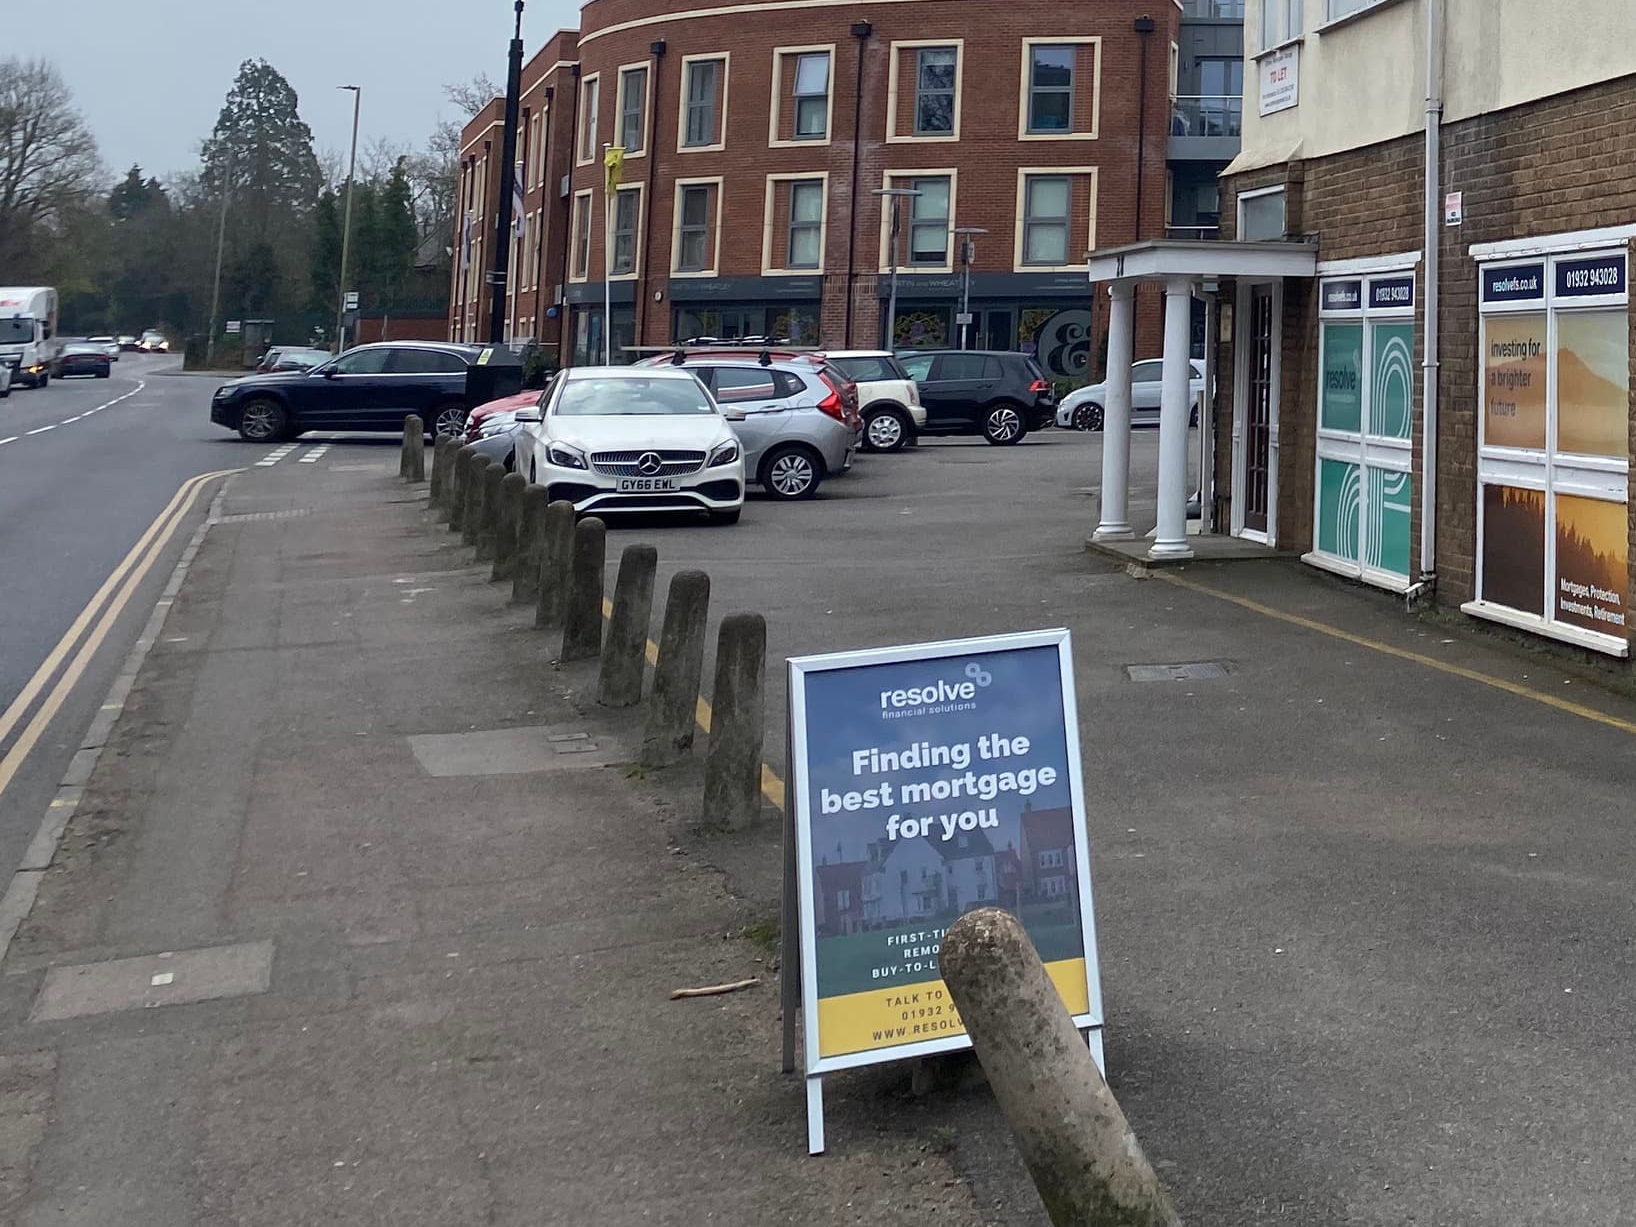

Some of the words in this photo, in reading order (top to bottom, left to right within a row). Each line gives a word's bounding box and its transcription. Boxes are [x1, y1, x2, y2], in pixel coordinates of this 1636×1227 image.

[1566, 270, 1589, 289] 01932
[1589, 266, 1618, 286] 943028
[1491, 337, 1527, 361] investing
[1528, 337, 1541, 357] for
[1490, 372, 1496, 387] a
[1497, 368, 1531, 391] brighter
[622, 479, 651, 490] GY66
[654, 479, 676, 490] EWL
[881, 679, 975, 709] resolve
[882, 707, 926, 719] financial
[929, 701, 976, 714] solutions
[853, 741, 971, 776] Finding
[978, 733, 1030, 760] the
[821, 782, 894, 814] best
[901, 766, 1057, 804] mortgage
[886, 814, 934, 841] for
[939, 808, 999, 840] you
[904, 944, 940, 959] REMO
[872, 960, 937, 979] BUY-TO-L
[886, 993, 919, 1007] TALK
[926, 990, 943, 1001] TO
[902, 1006, 942, 1021] 01932
[872, 1018, 964, 1041] WWW.RESOLV
